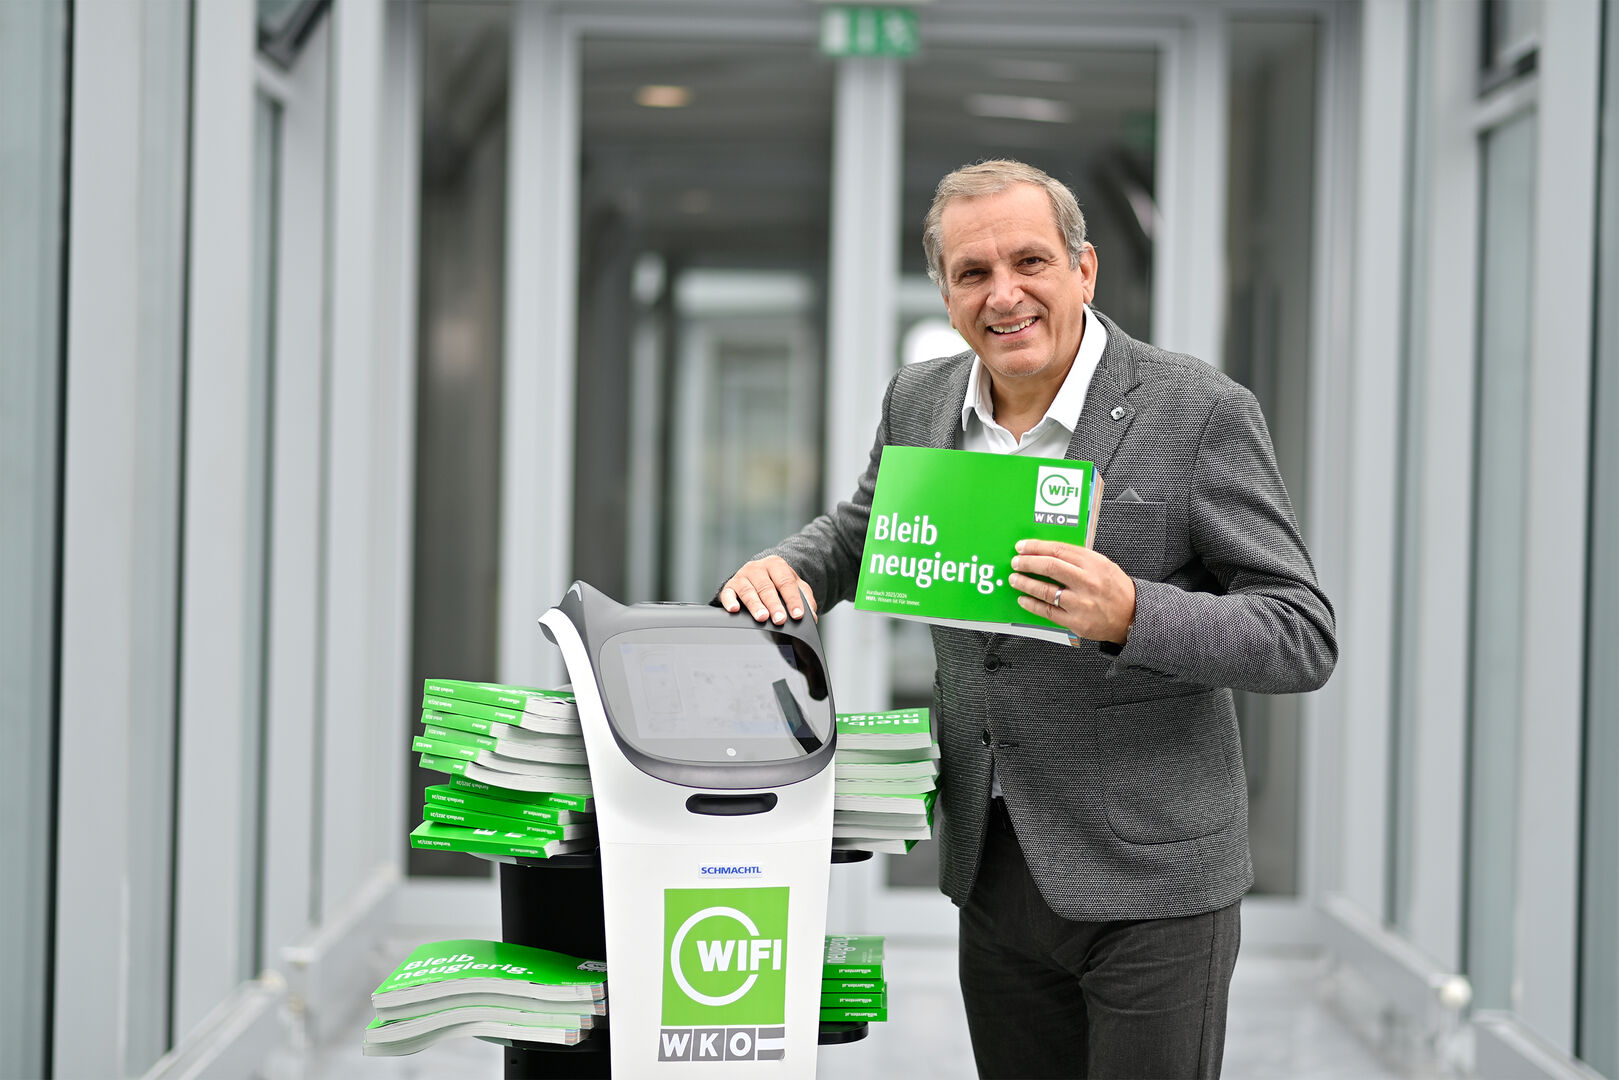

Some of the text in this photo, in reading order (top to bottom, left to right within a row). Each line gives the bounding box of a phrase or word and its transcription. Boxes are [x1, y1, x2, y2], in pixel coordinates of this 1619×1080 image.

[1048, 485, 1079, 497] WIFI
[874, 512, 938, 545] Bleib
[1034, 513, 1066, 524] WKO
[869, 551, 1003, 594] neugierig.
[701, 866, 762, 875] SCHMACHTL
[403, 953, 475, 971] Bleib
[696, 939, 782, 972] WIFI
[394, 960, 534, 981] neugierig.
[661, 1032, 752, 1057] WKO
